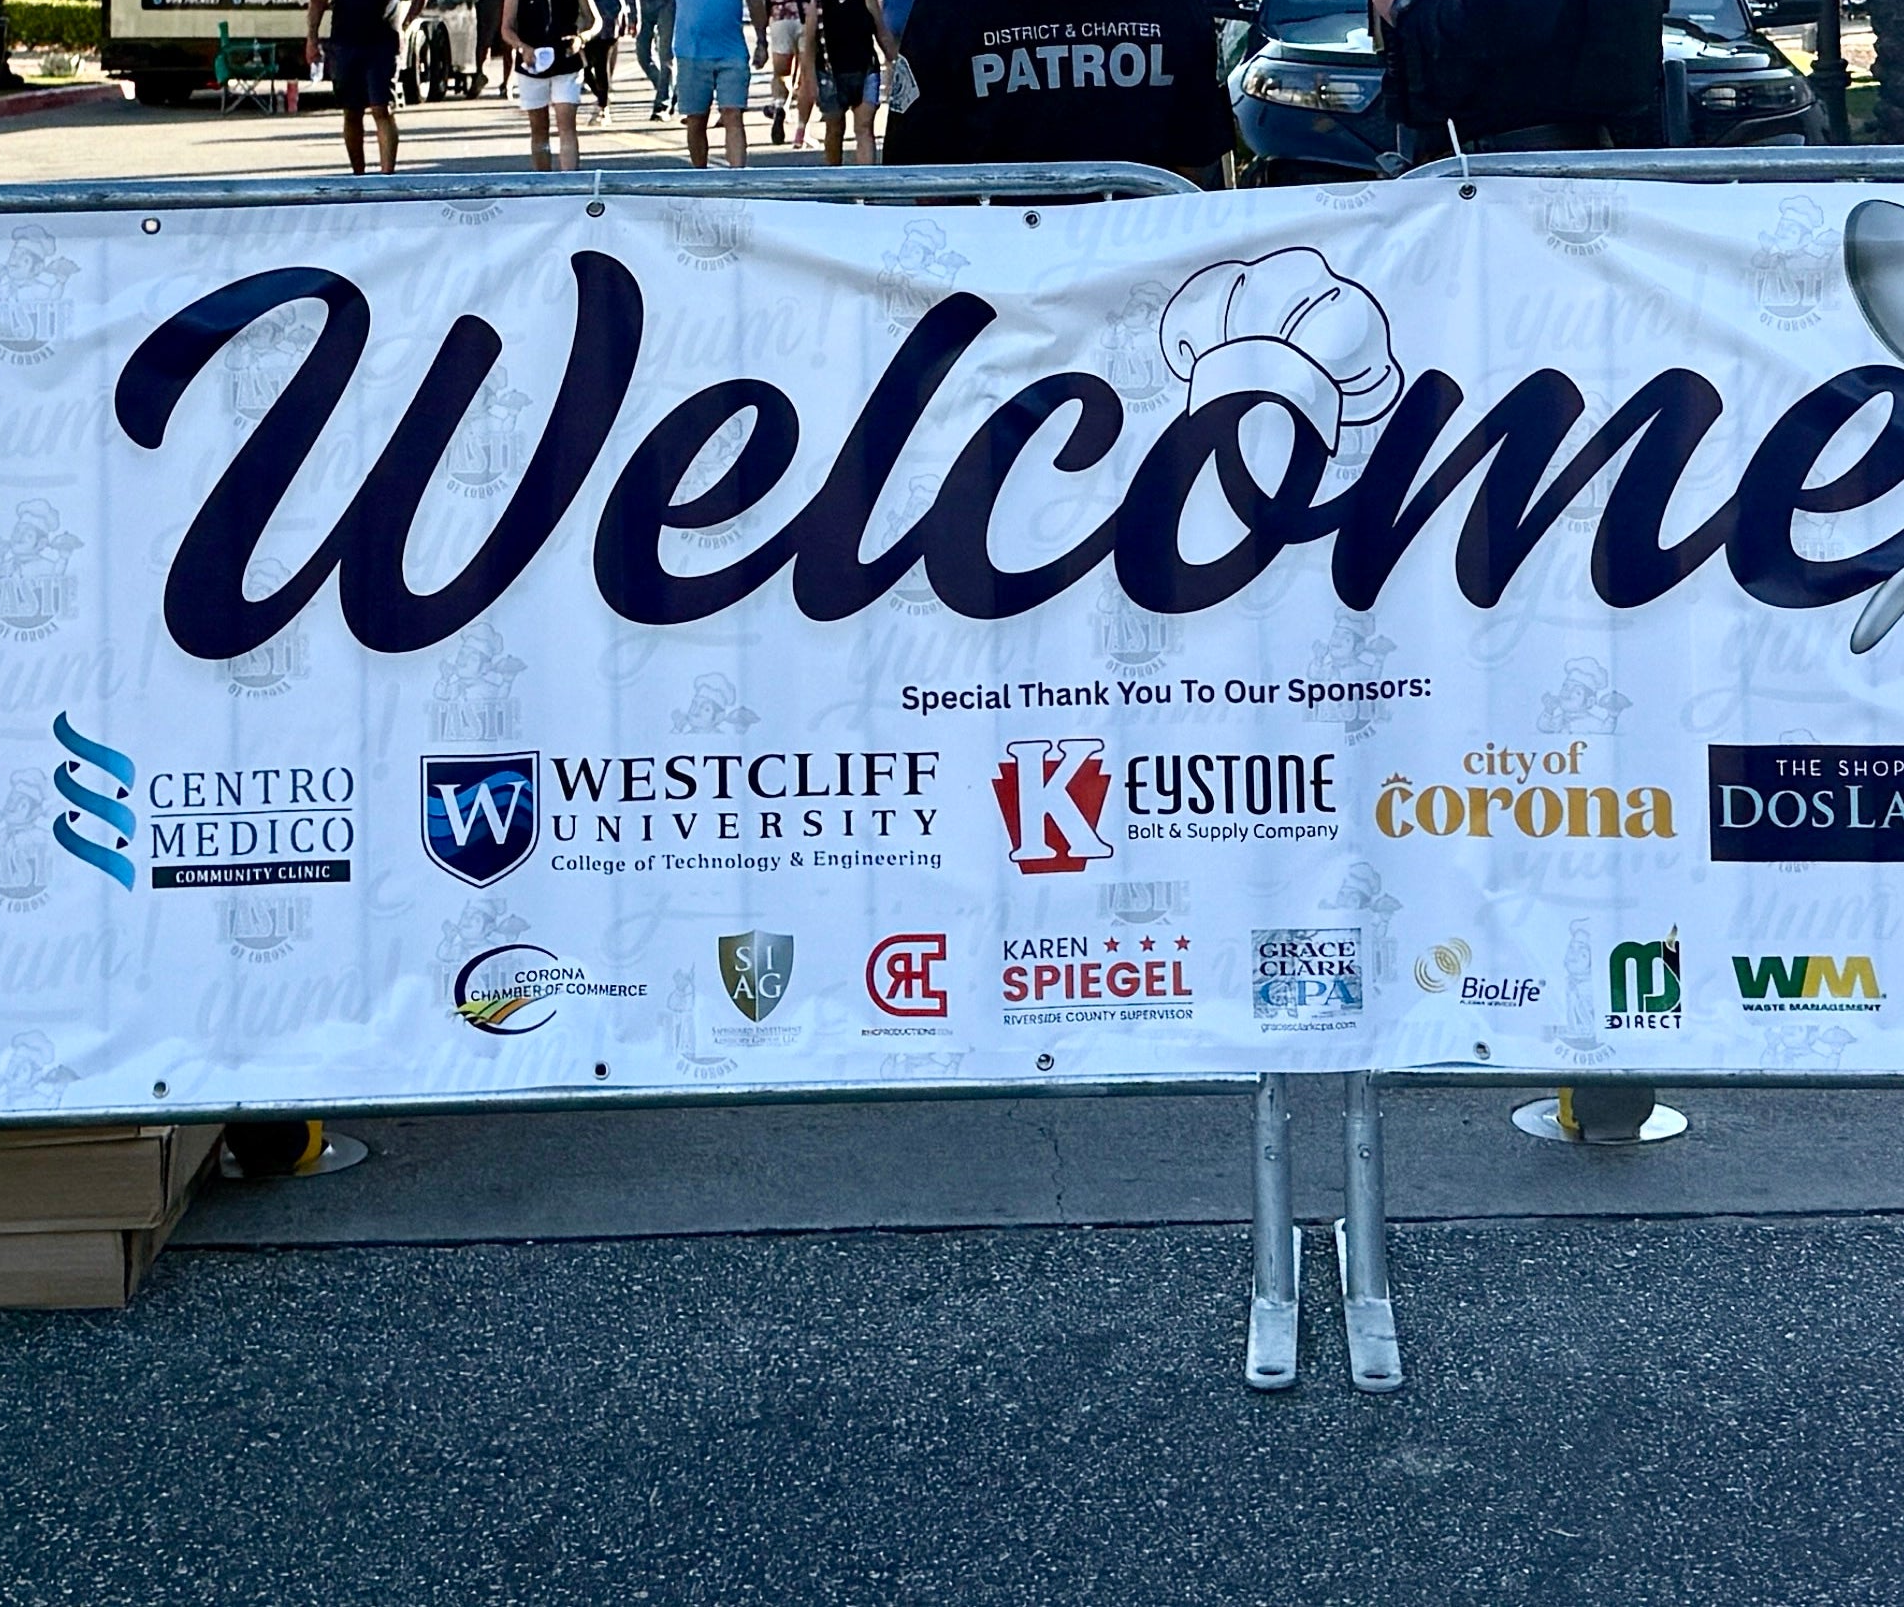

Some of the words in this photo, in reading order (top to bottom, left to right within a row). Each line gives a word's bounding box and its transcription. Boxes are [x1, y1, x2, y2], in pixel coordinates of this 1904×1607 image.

[983, 22, 1060, 48] DISTRICT
[1065, 22, 1078, 40] &
[1081, 21, 1162, 39] CHARTER
[971, 41, 1175, 99] PATROL
[902, 685, 1011, 716] Special
[1018, 681, 1110, 706] Thank
[1116, 680, 1172, 705] You
[1180, 680, 1218, 704] To
[1224, 678, 1282, 703] Our
[1287, 675, 1432, 708] Sponsors:
[1463, 742, 1538, 785] city
[1542, 740, 1587, 775] of
[1776, 759, 1822, 777] THE
[149, 766, 355, 810] CENTRO
[551, 751, 941, 802] WESTCLIFF
[1374, 774, 1678, 839] corona
[150, 816, 355, 859] MEDICO
[551, 808, 939, 843] UNIVERSITY
[1128, 823, 1165, 840] Bolt
[1169, 824, 1183, 840] &
[1187, 822, 1249, 843] Supply
[1253, 821, 1339, 842] Company
[175, 866, 272, 885] COMMUNITY
[277, 863, 332, 882] CLINIC
[551, 854, 628, 876] College
[634, 854, 656, 871] of
[662, 852, 782, 874] Technology
[790, 851, 805, 868] &
[813, 849, 943, 871] Engineering
[1003, 936, 1088, 961] KAREN
[1258, 941, 1356, 959] GRACE
[514, 967, 586, 984] CORONA
[1002, 960, 1193, 1002] SPIEGEL
[1258, 959, 1356, 977] CLARK
[1731, 956, 1881, 999] WM
[470, 984, 542, 1002] CHAMBER
[544, 982, 566, 996] OF
[566, 982, 648, 997] COMMERCE
[1258, 979, 1356, 1007] CPA
[1003, 1012, 1062, 1026] RIVERSIDE
[1065, 1010, 1116, 1024] COUNTY
[1119, 1008, 1194, 1022] SUPERVISOR
[1742, 1004, 1787, 1013] WASTE
[1789, 1003, 1882, 1012] MANAGEMENT
